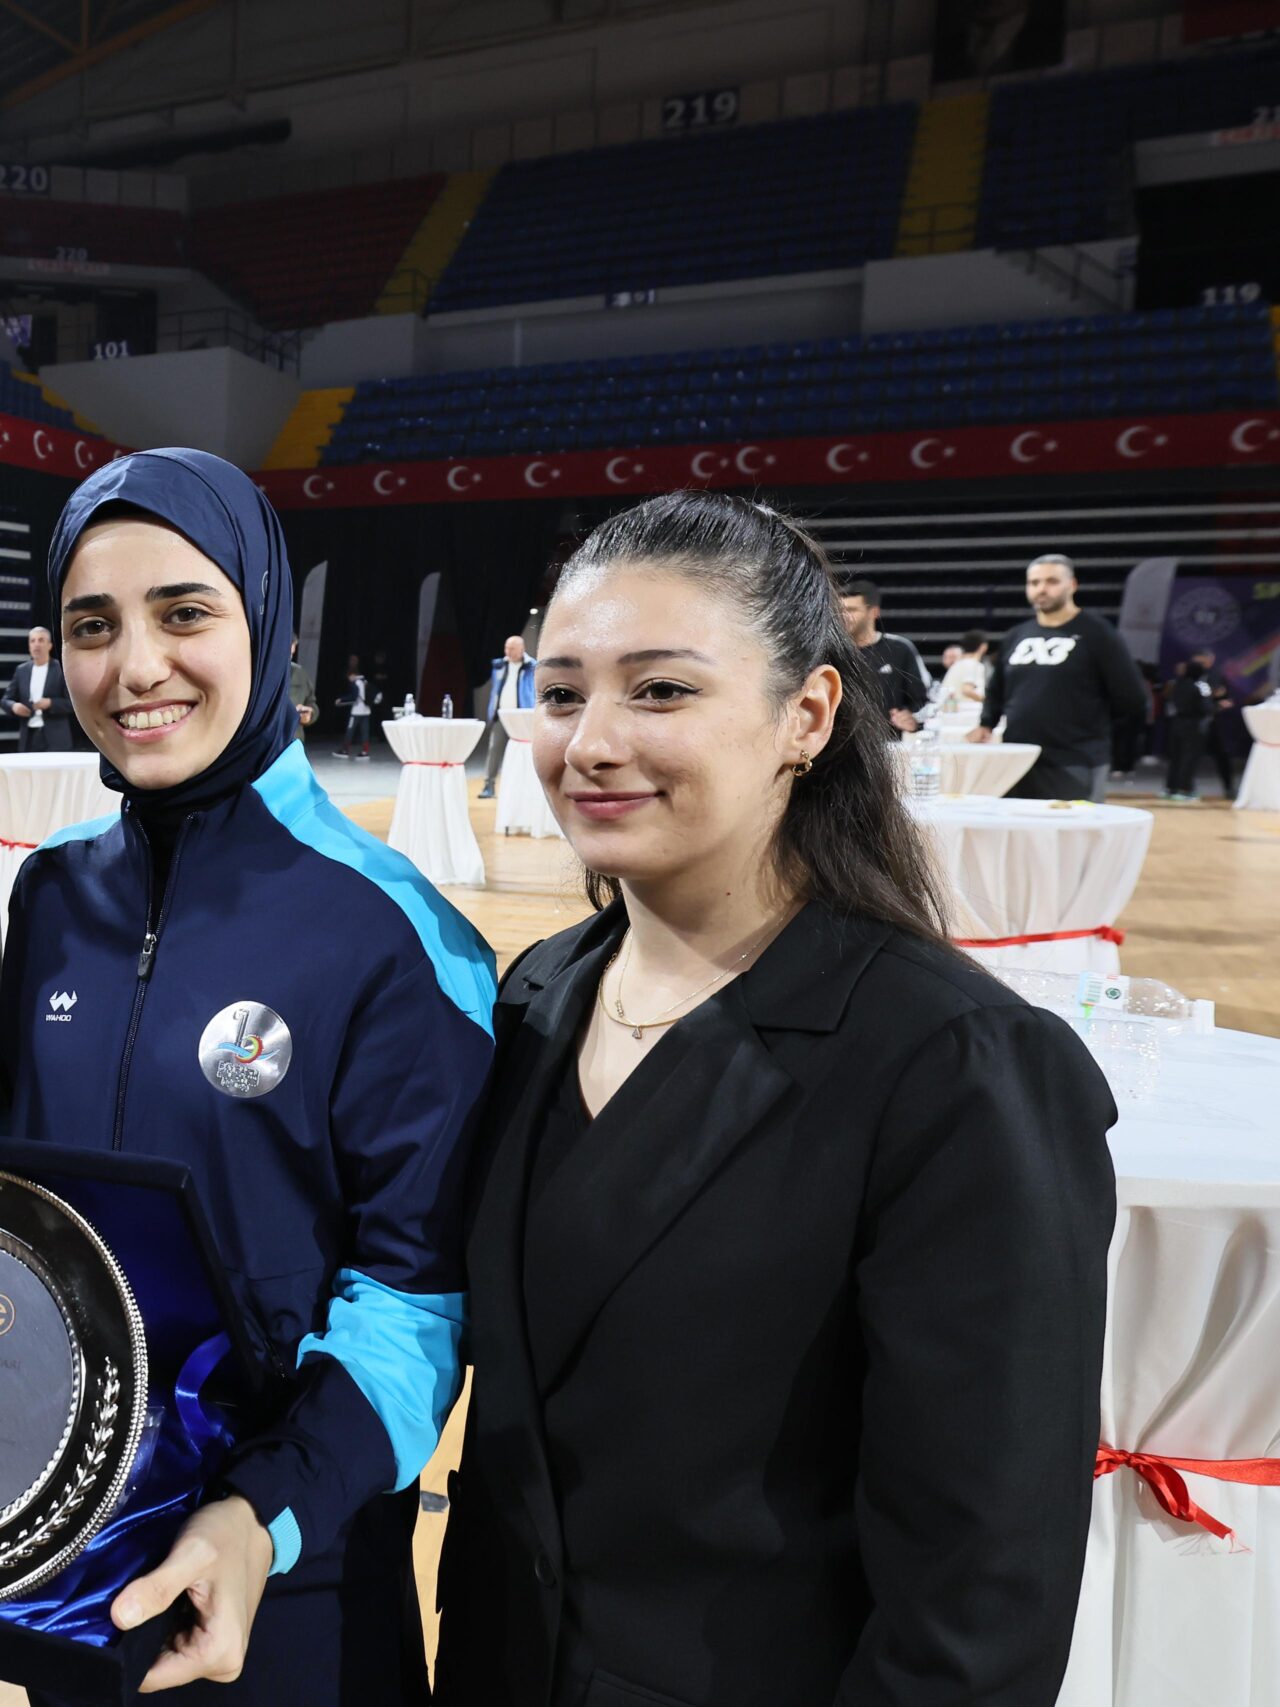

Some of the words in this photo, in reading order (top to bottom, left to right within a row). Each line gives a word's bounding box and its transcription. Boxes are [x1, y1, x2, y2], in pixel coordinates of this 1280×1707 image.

[664, 91, 736, 128] 219
[1202, 282, 1261, 307] 119
[94, 340, 129, 360] 101
[45, 1014, 72, 1022] WAHOO
